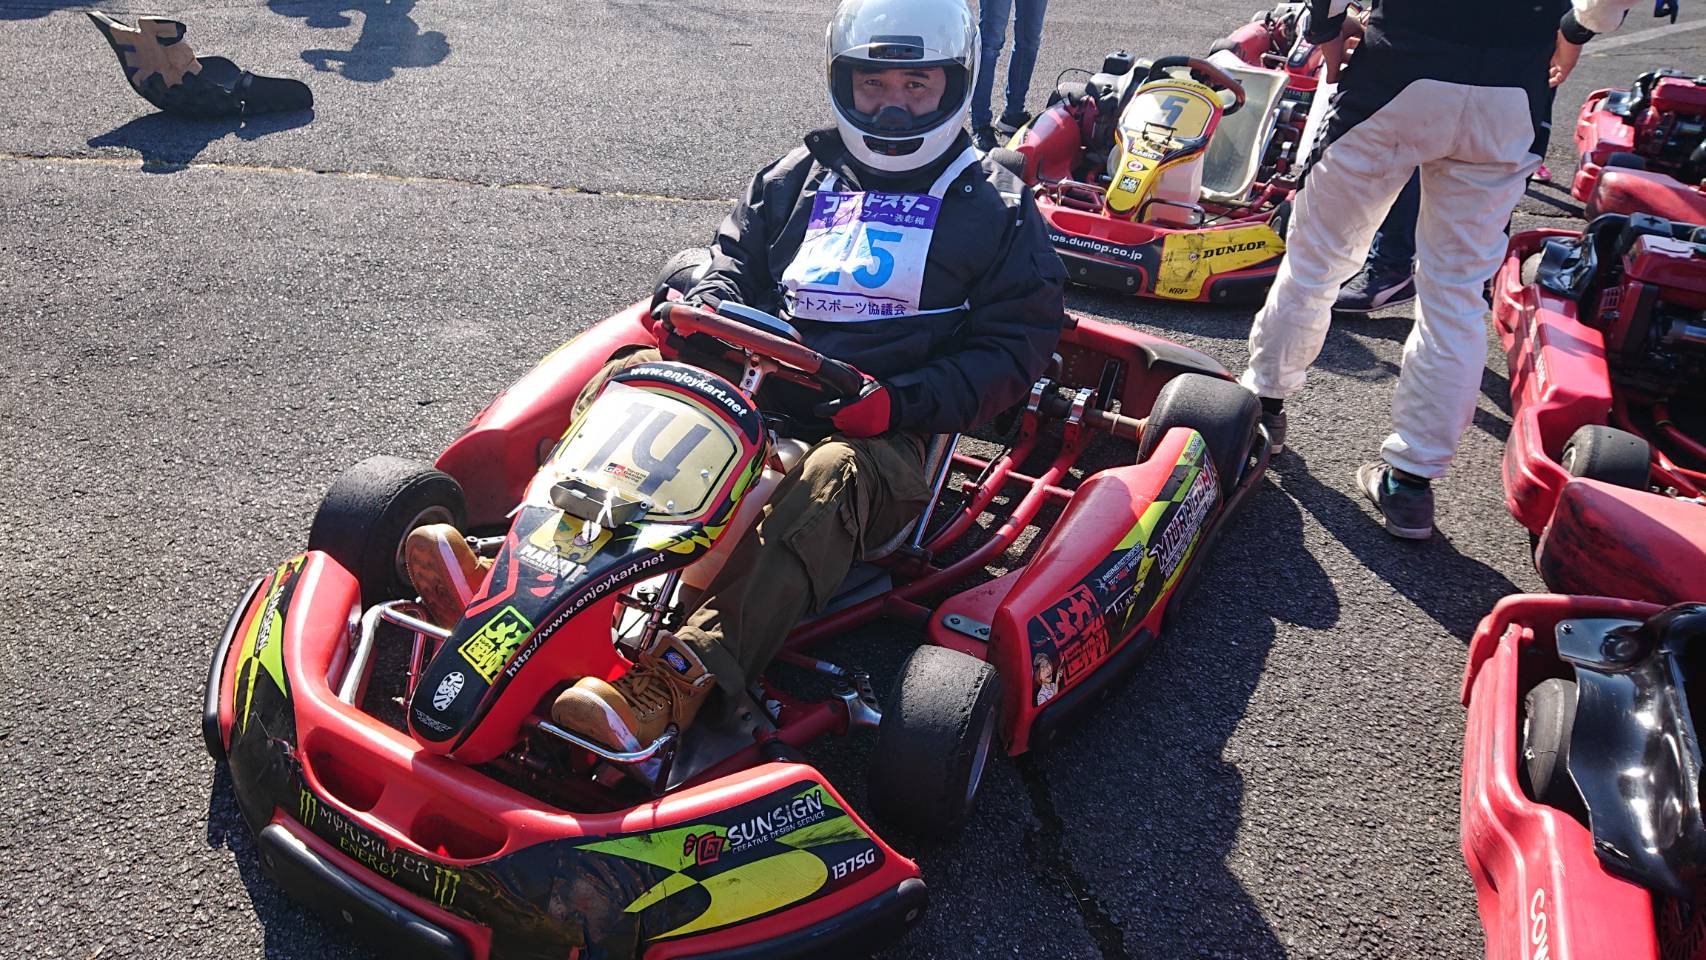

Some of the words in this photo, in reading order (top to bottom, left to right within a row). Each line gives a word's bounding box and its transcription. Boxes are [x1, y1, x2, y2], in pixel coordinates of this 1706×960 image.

[1160, 95, 1190, 126] 5
[1203, 241, 1266, 259] DUNLOP
[630, 367, 747, 417] www.enjoykart.net
[583, 402, 713, 497] 14
[505, 552, 665, 677] http://www.enjoykart.net
[732, 835, 769, 854] CREATIVE
[770, 823, 796, 840] DESIGN
[797, 811, 826, 828] SERVICE
[340, 837, 399, 878] ENERGY
[831, 848, 875, 880] 137SG
